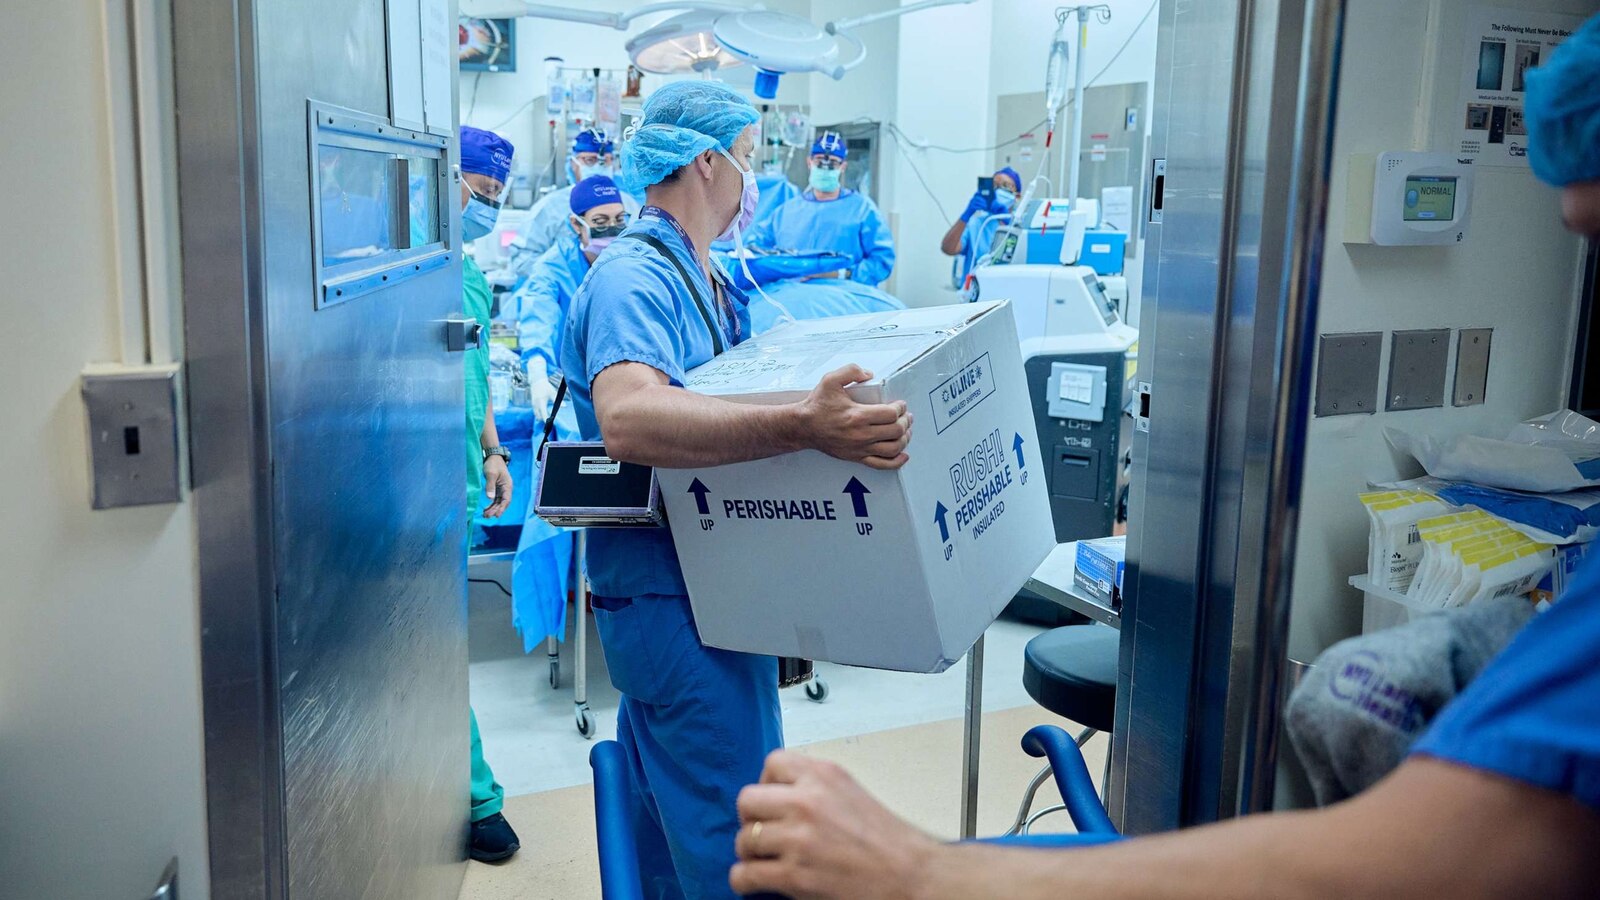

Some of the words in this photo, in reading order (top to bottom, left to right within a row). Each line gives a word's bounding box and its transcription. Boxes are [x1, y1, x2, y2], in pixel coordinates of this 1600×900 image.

[1491, 23, 1501, 31] The
[1501, 24, 1524, 34] Following
[1524, 26, 1537, 34] Must
[1537, 28, 1551, 36] Never
[1420, 186, 1452, 196] NORMAL
[949, 369, 976, 400] ULINE
[949, 427, 1005, 504] RUSH!
[1019, 471, 1028, 486] UP
[955, 464, 1013, 533] PERISHABLE
[722, 499, 838, 521] PERISHABLE
[699, 518, 715, 532] UP
[855, 522, 873, 536] UP
[972, 500, 1005, 541] INSULATED
[943, 543, 954, 562] UP
